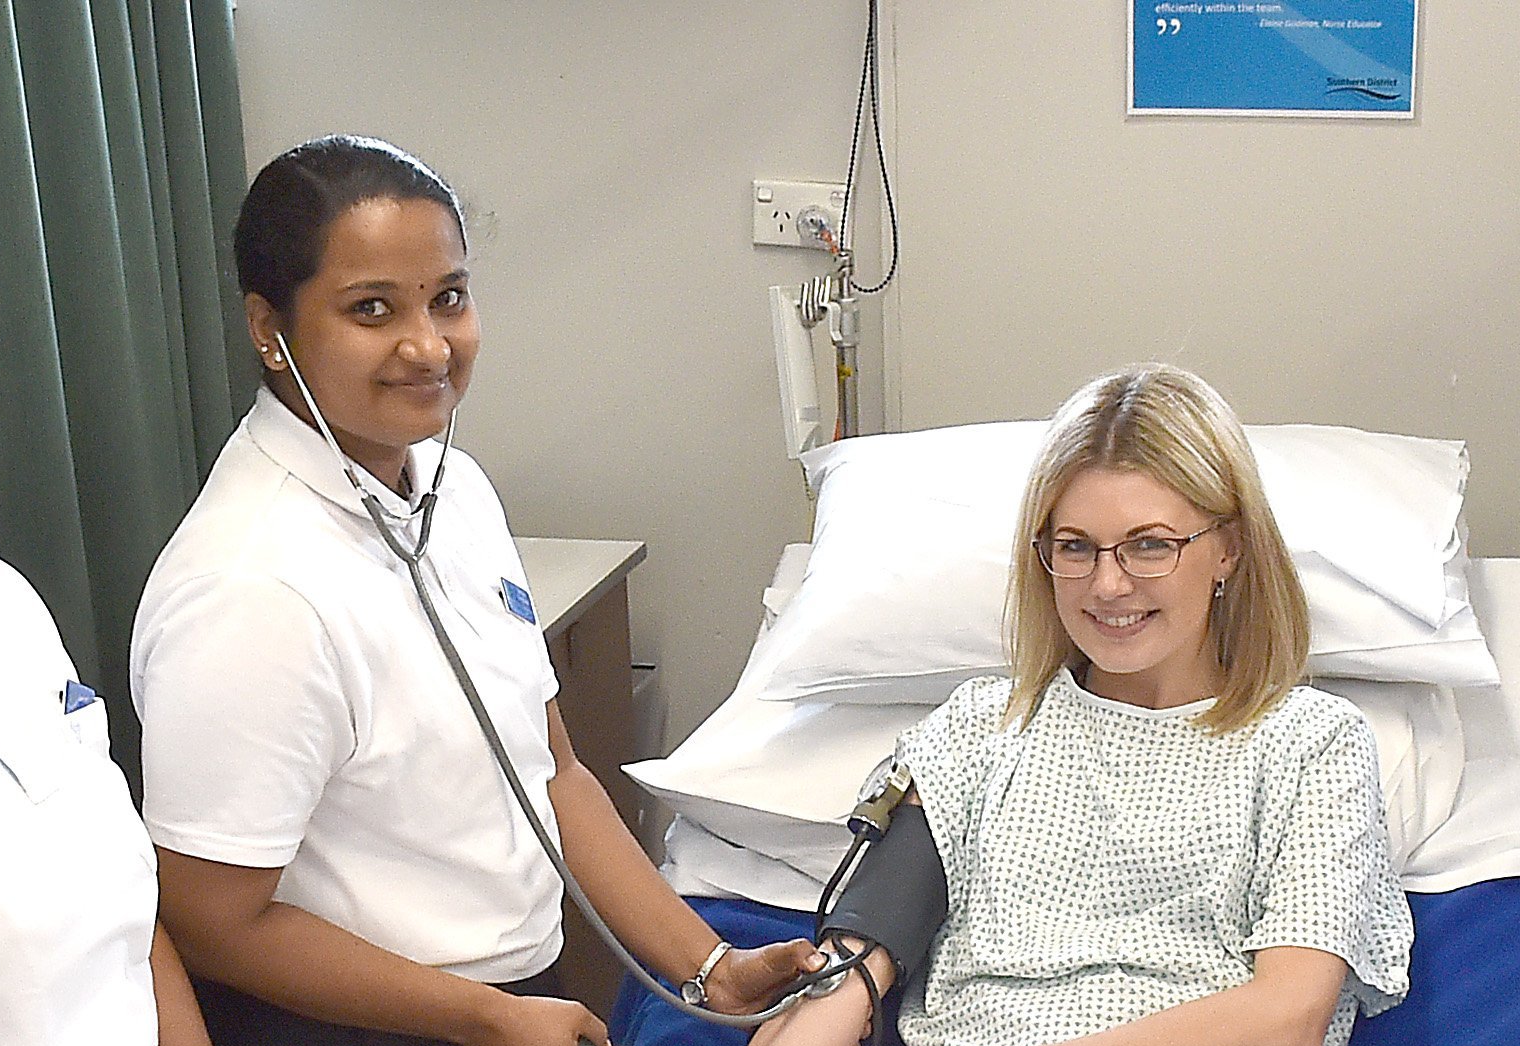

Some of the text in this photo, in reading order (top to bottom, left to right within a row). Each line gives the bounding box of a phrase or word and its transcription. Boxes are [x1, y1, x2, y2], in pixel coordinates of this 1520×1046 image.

[1205, 3, 1236, 13] within
[1237, 3, 1255, 13] the
[1367, 77, 1398, 87] District
